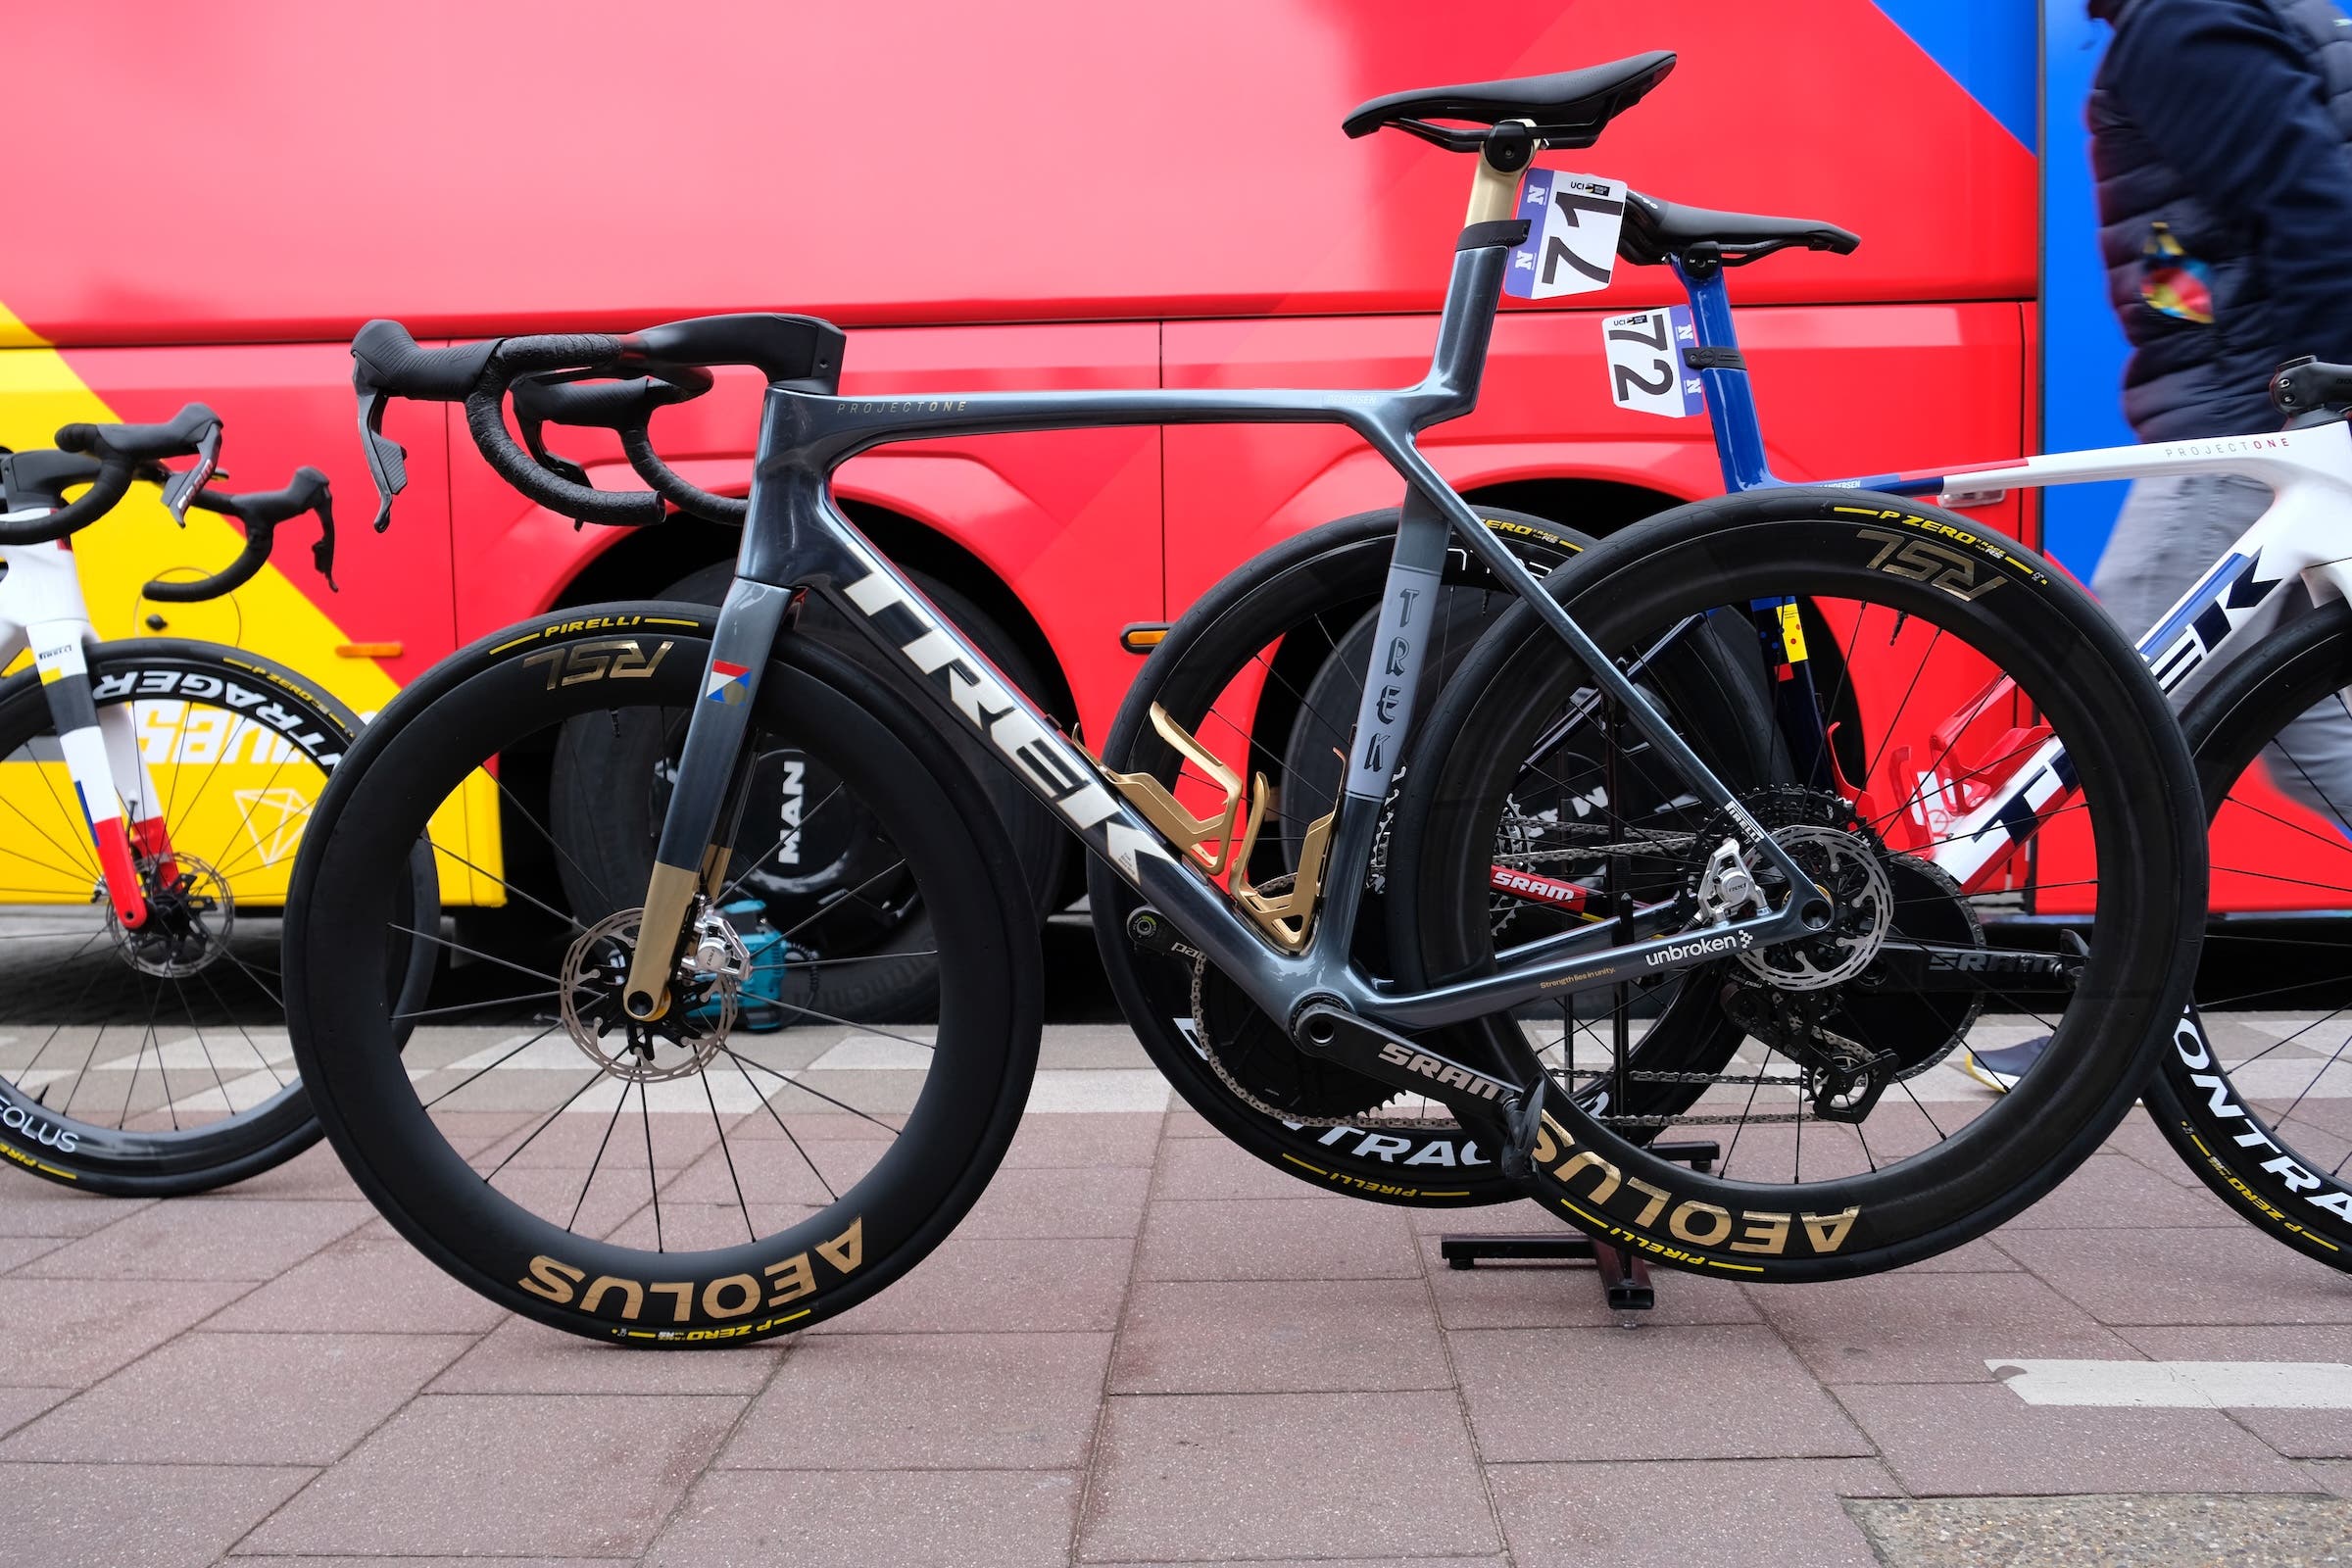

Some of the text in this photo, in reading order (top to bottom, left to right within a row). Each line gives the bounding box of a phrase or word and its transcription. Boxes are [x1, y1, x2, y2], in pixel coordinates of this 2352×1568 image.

[1570, 181, 1585, 190] UCI
[1542, 191, 1624, 284] 71
[1608, 314, 1674, 401] 72
[1481, 518, 1533, 535] ERO
[1879, 510, 1900, 519] P
[1901, 515, 1977, 545] ZERO
[545, 615, 641, 637] PIRELLI
[1363, 588, 1420, 772] TREK
[843, 543, 1183, 886] TREK
[778, 761, 805, 864] MAN
[1724, 800, 1765, 843] PIRELLI
[1492, 871, 1575, 903] SRAM
[1645, 935, 1738, 967] unbroken
[1378, 1042, 1504, 1102] SRAM
[2173, 1004, 2352, 1225] ONTRA
[1329, 1170, 1417, 1198] PIRELLI
[2228, 1177, 2284, 1221] ZERO
[1609, 1227, 1706, 1265] PIRELLI
[517, 1216, 863, 1322] AEOLUS
[685, 1324, 752, 1342] ZERO
[756, 1318, 774, 1334] P
